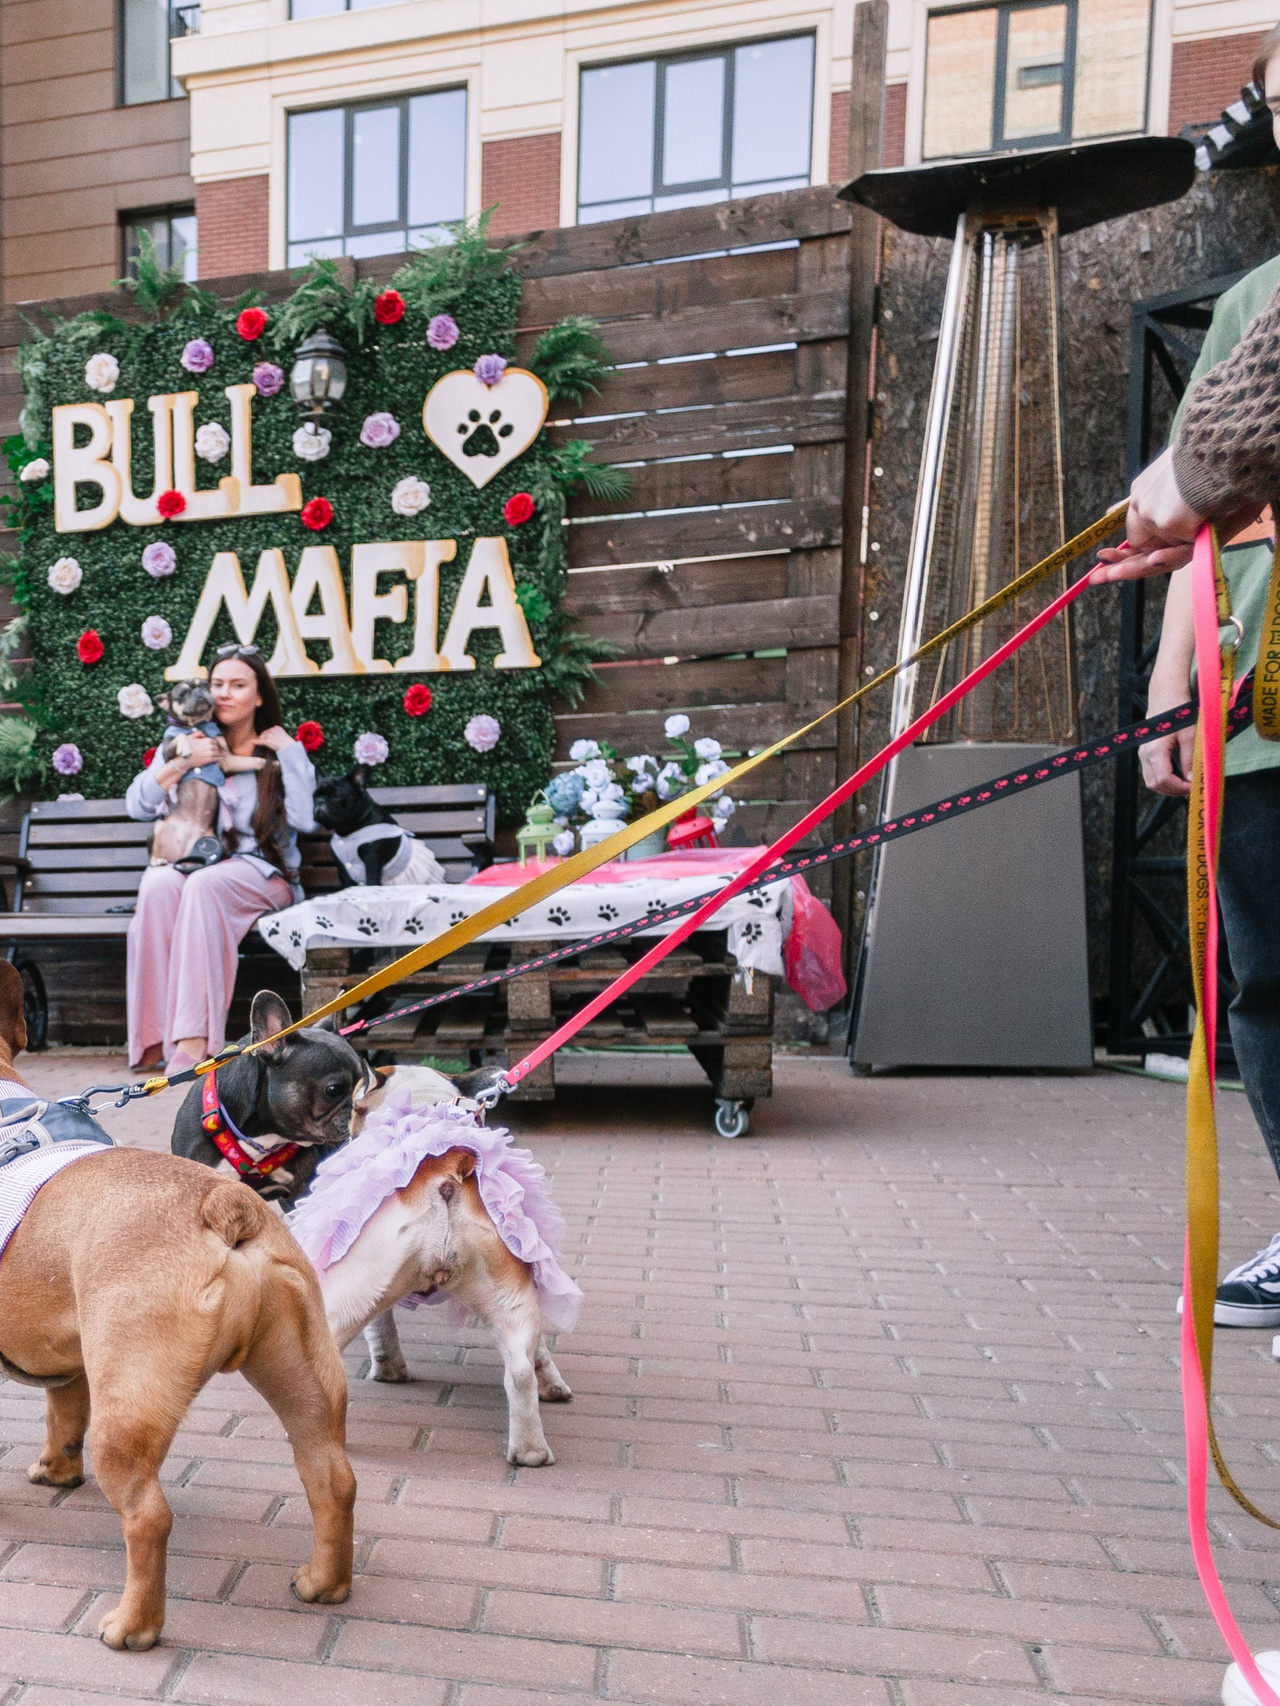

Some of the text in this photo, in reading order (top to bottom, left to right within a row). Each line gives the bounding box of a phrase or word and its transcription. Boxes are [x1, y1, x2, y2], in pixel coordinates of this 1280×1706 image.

[52, 384, 302, 533] BULL
[164, 536, 542, 682] MAFIA
[1003, 570, 1043, 600] MADE
[1045, 548, 1075, 571] FOR
[1094, 511, 1127, 537] DOG
[1262, 649, 1280, 728] MADE FOR
